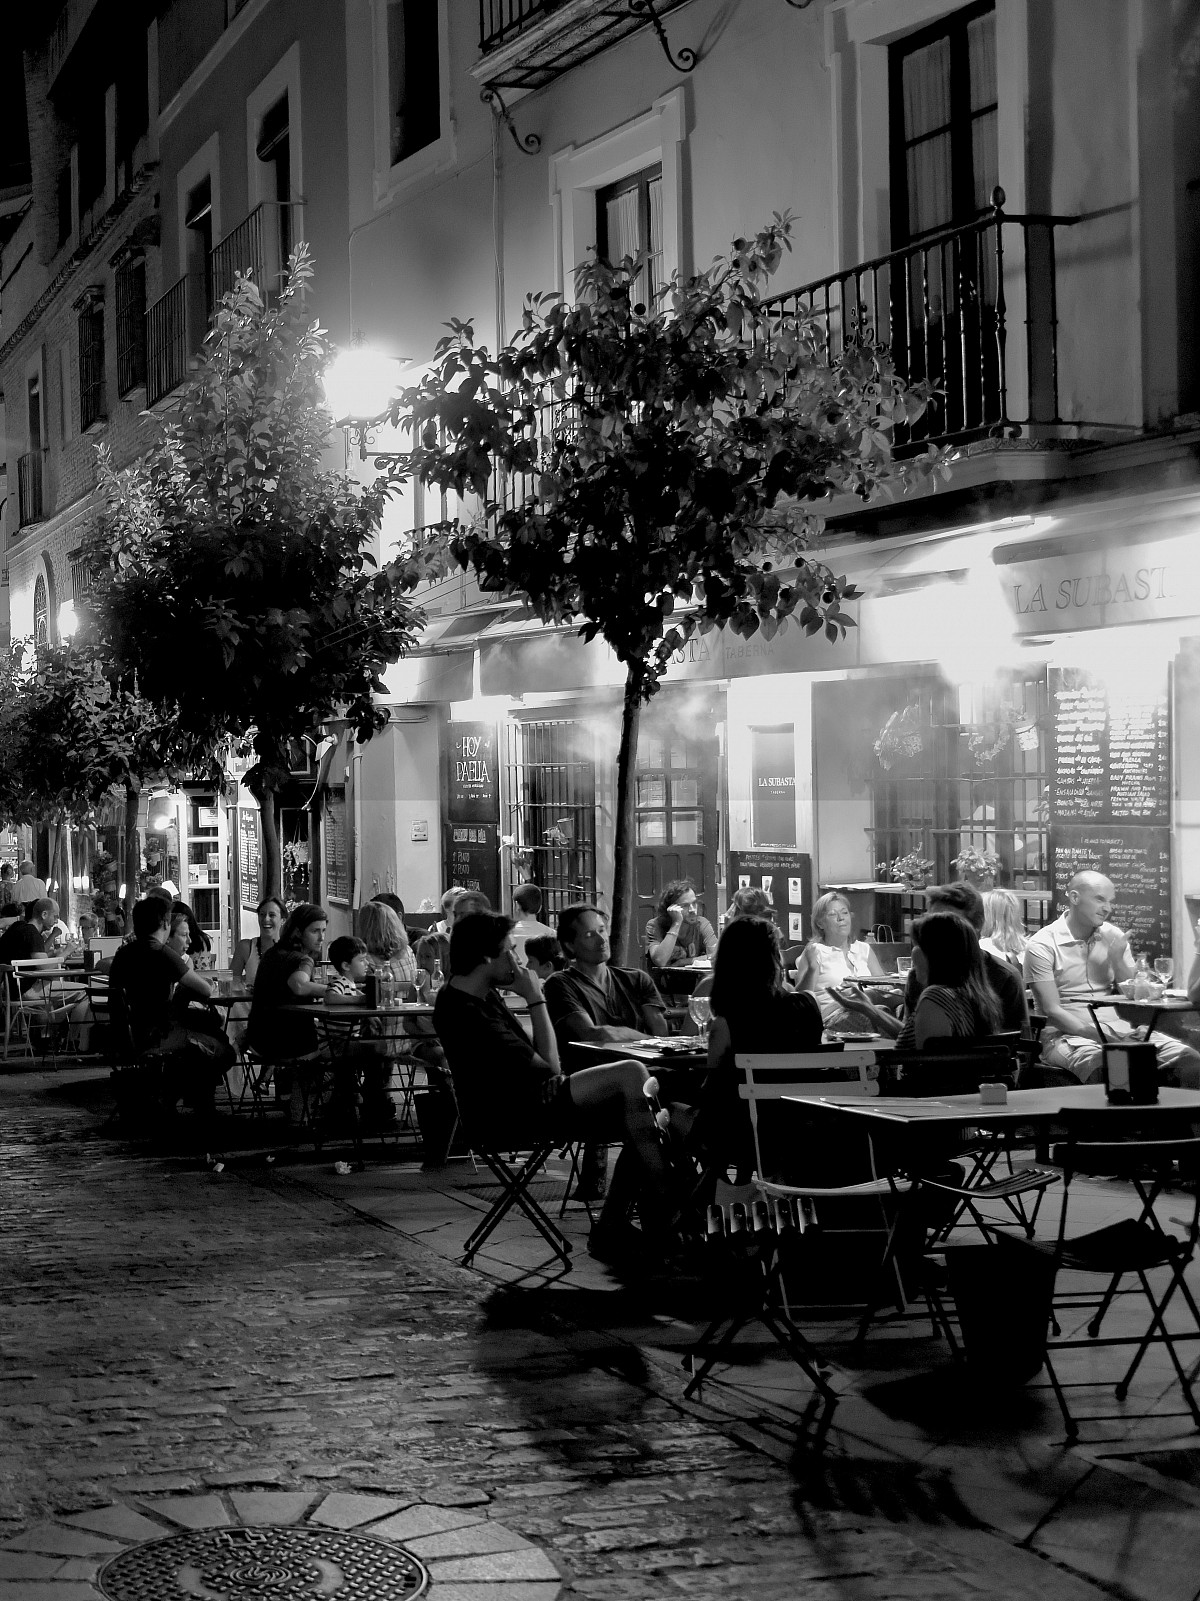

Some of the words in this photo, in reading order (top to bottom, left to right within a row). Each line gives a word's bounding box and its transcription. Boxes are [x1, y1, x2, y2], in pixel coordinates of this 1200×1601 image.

[1013, 583, 1048, 614] LA
[1055, 566, 1177, 609] SUBAST
[725, 645, 774, 660] TABERNA
[462, 736, 482, 757] HOY
[456, 760, 491, 783] PAELLA
[758, 777, 768, 787] LA
[768, 777, 796, 787] SUBASTA
